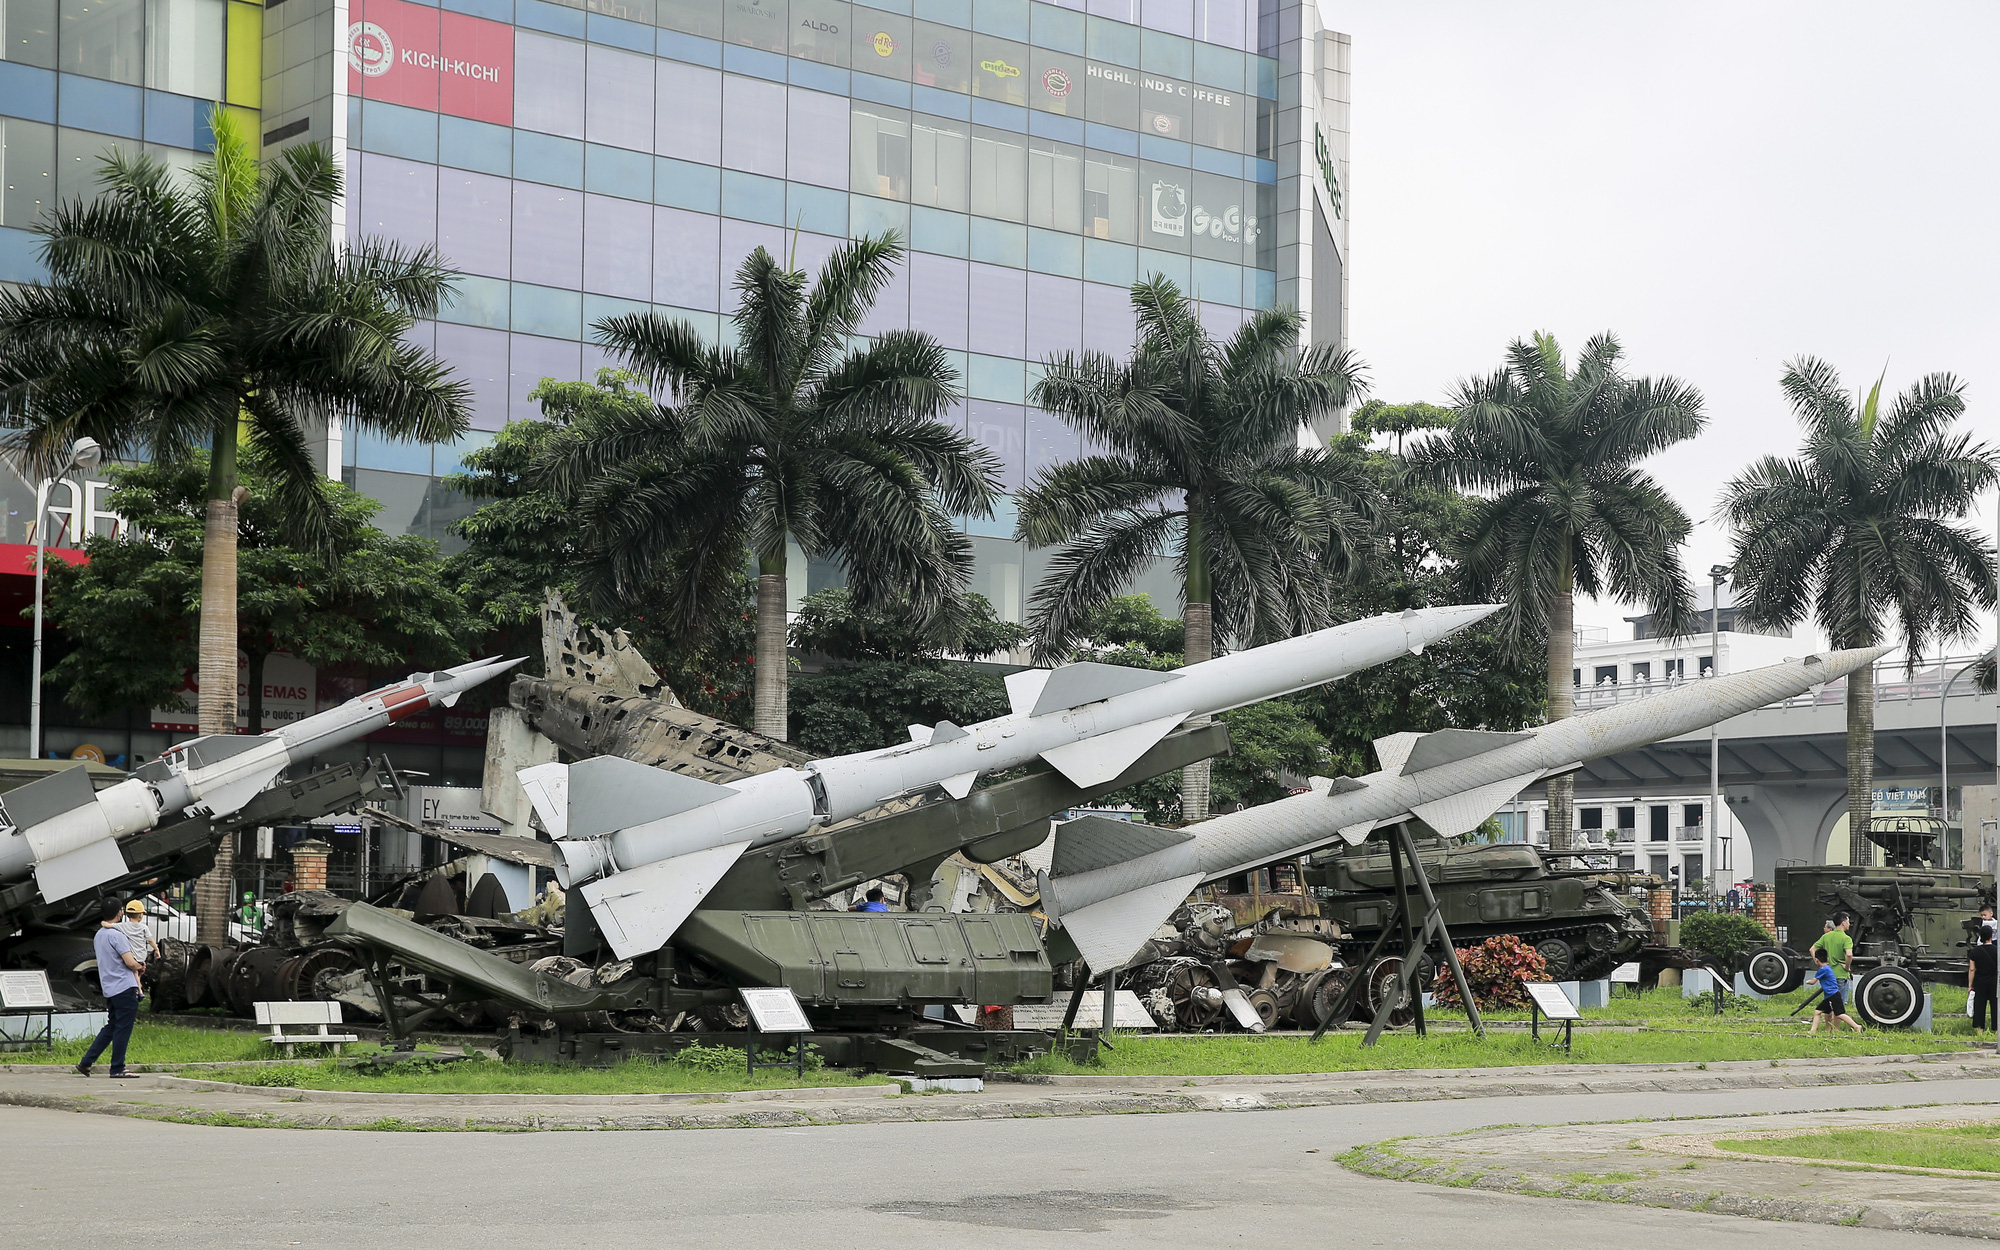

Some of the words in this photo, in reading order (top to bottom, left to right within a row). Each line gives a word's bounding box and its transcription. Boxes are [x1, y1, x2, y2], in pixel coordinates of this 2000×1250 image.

[736, 4, 776, 20] SWAROVSKI
[801, 18, 839, 35] ALDO
[401, 48, 498, 83] KICHI-KICHI
[237, 683, 307, 700] CIEMAS
[423, 798, 440, 819] EY
